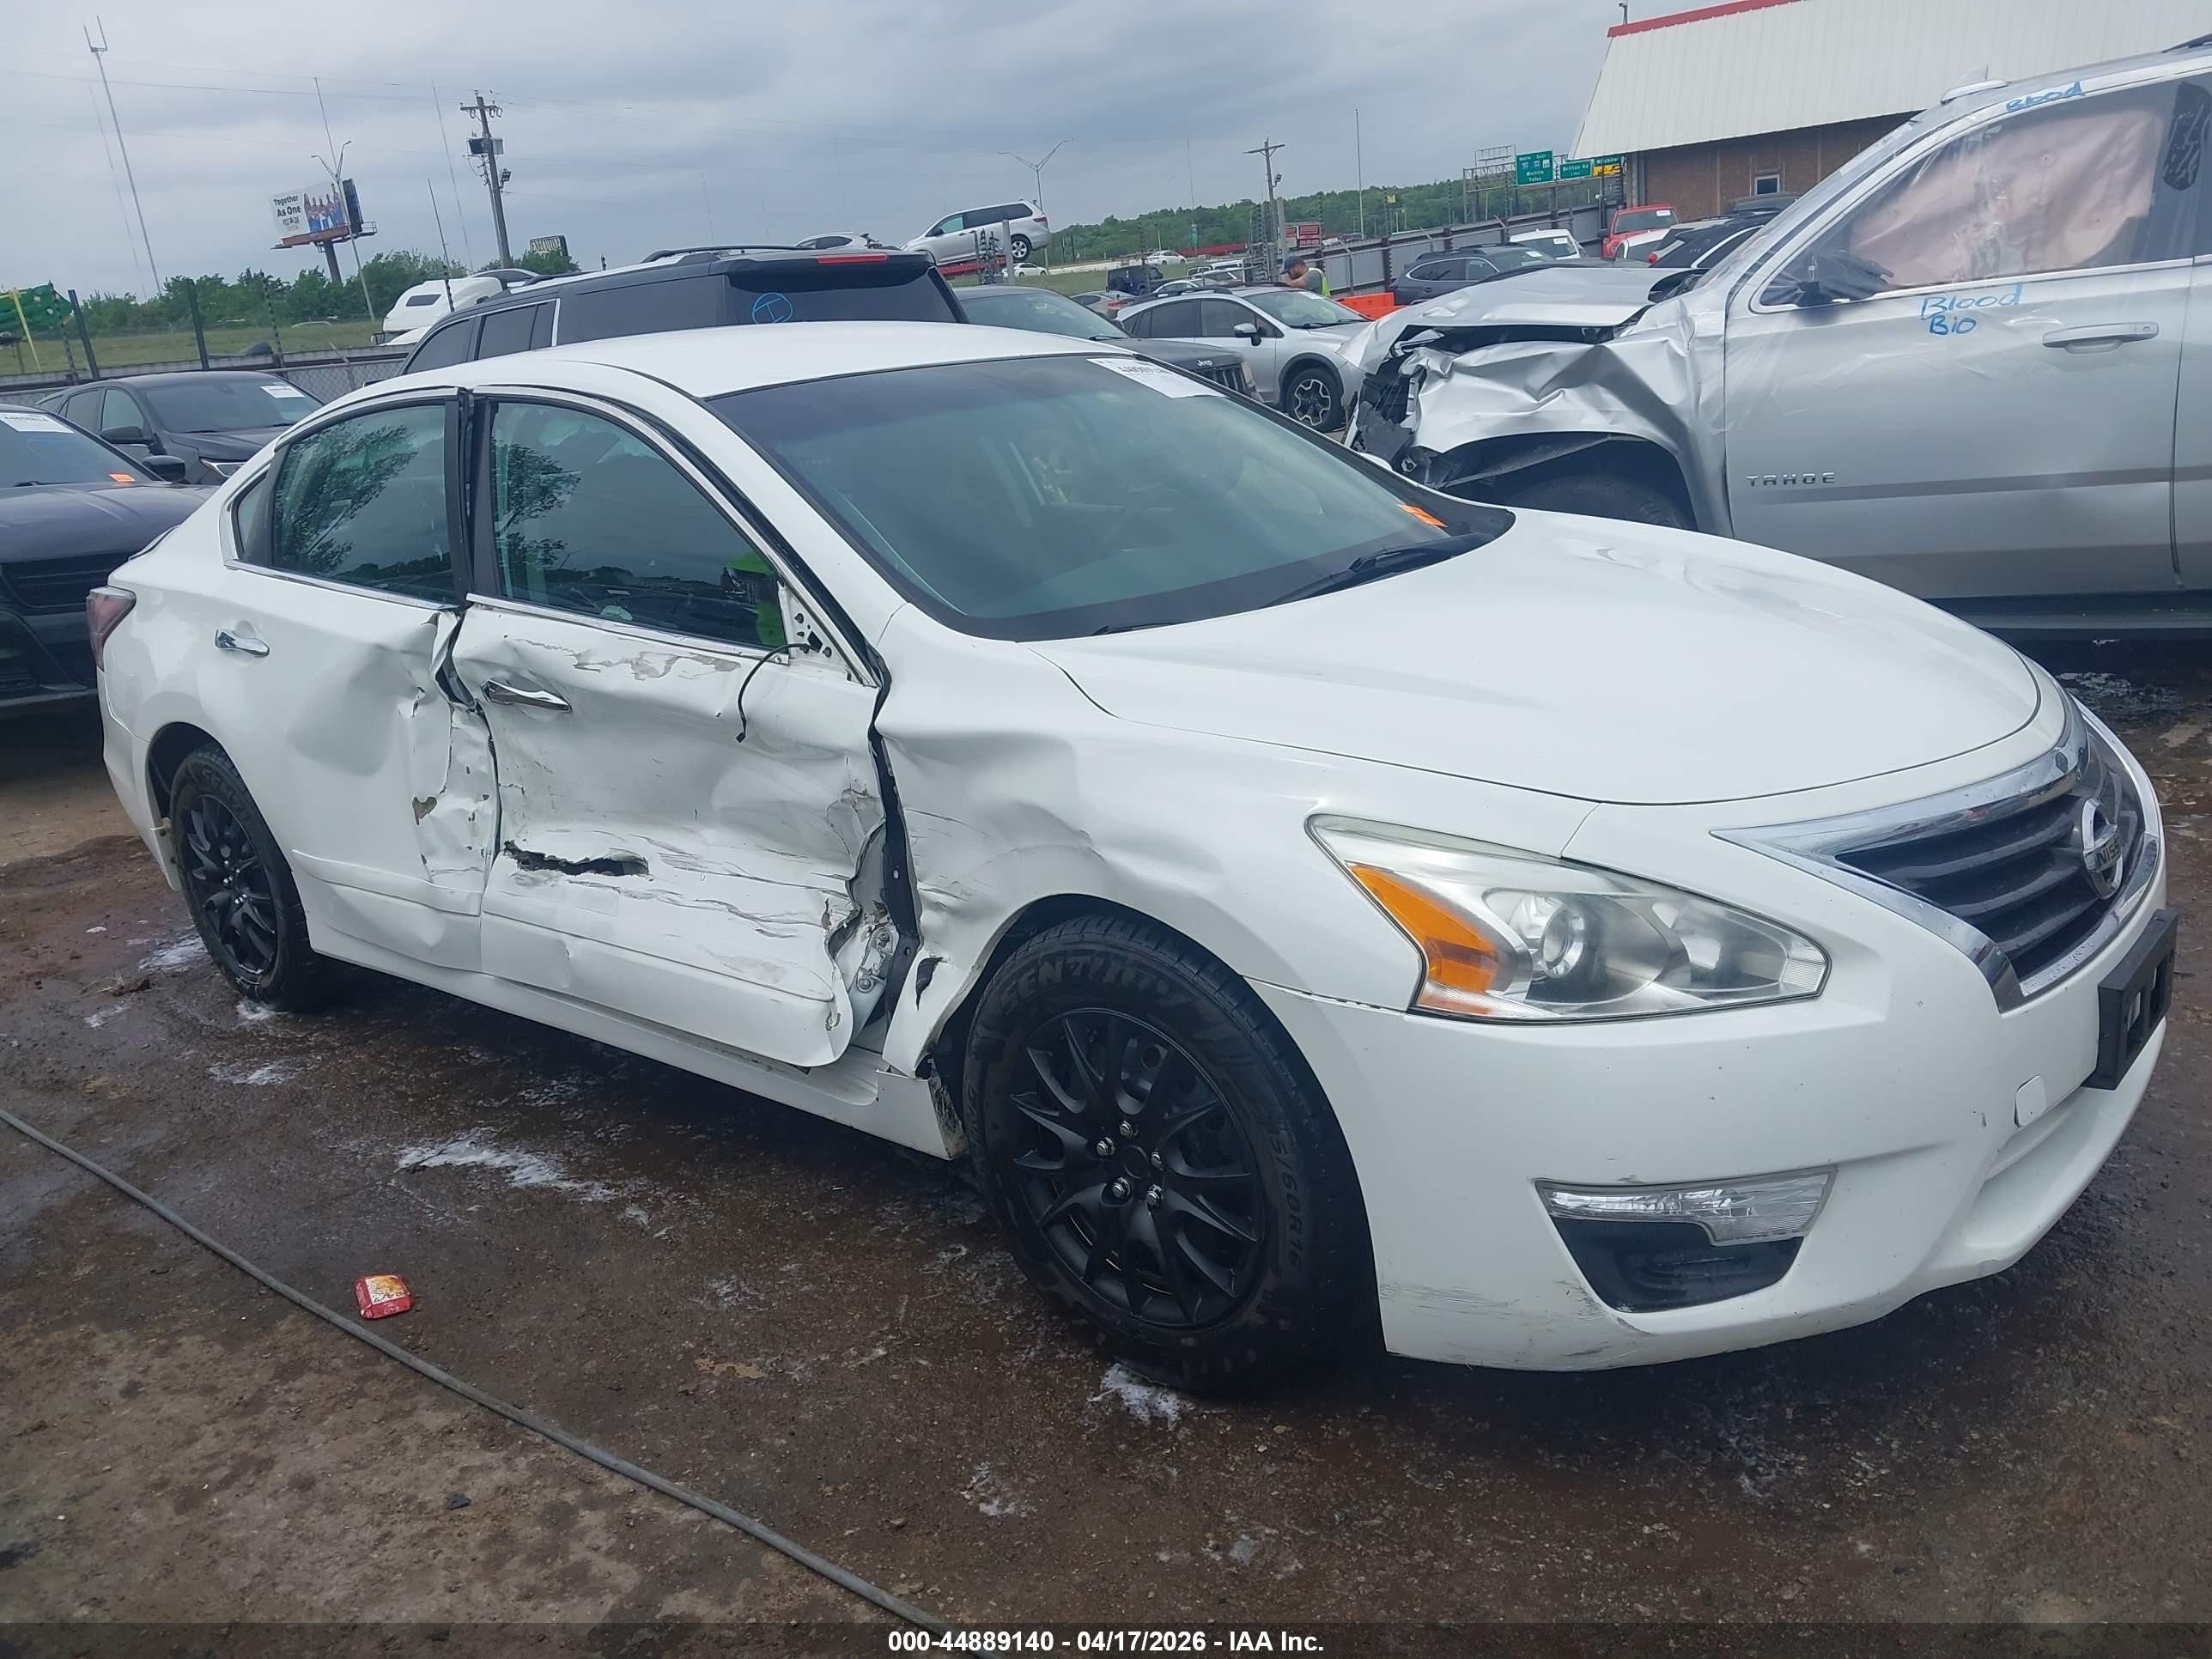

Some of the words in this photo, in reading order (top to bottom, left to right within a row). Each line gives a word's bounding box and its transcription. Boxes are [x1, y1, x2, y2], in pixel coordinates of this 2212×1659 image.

[273, 195, 299, 206] Together
[277, 209, 287, 217] As
[287, 205, 301, 215] One
[1921, 284, 2022, 320] Blood
[1746, 472, 1835, 487] TAHOE
